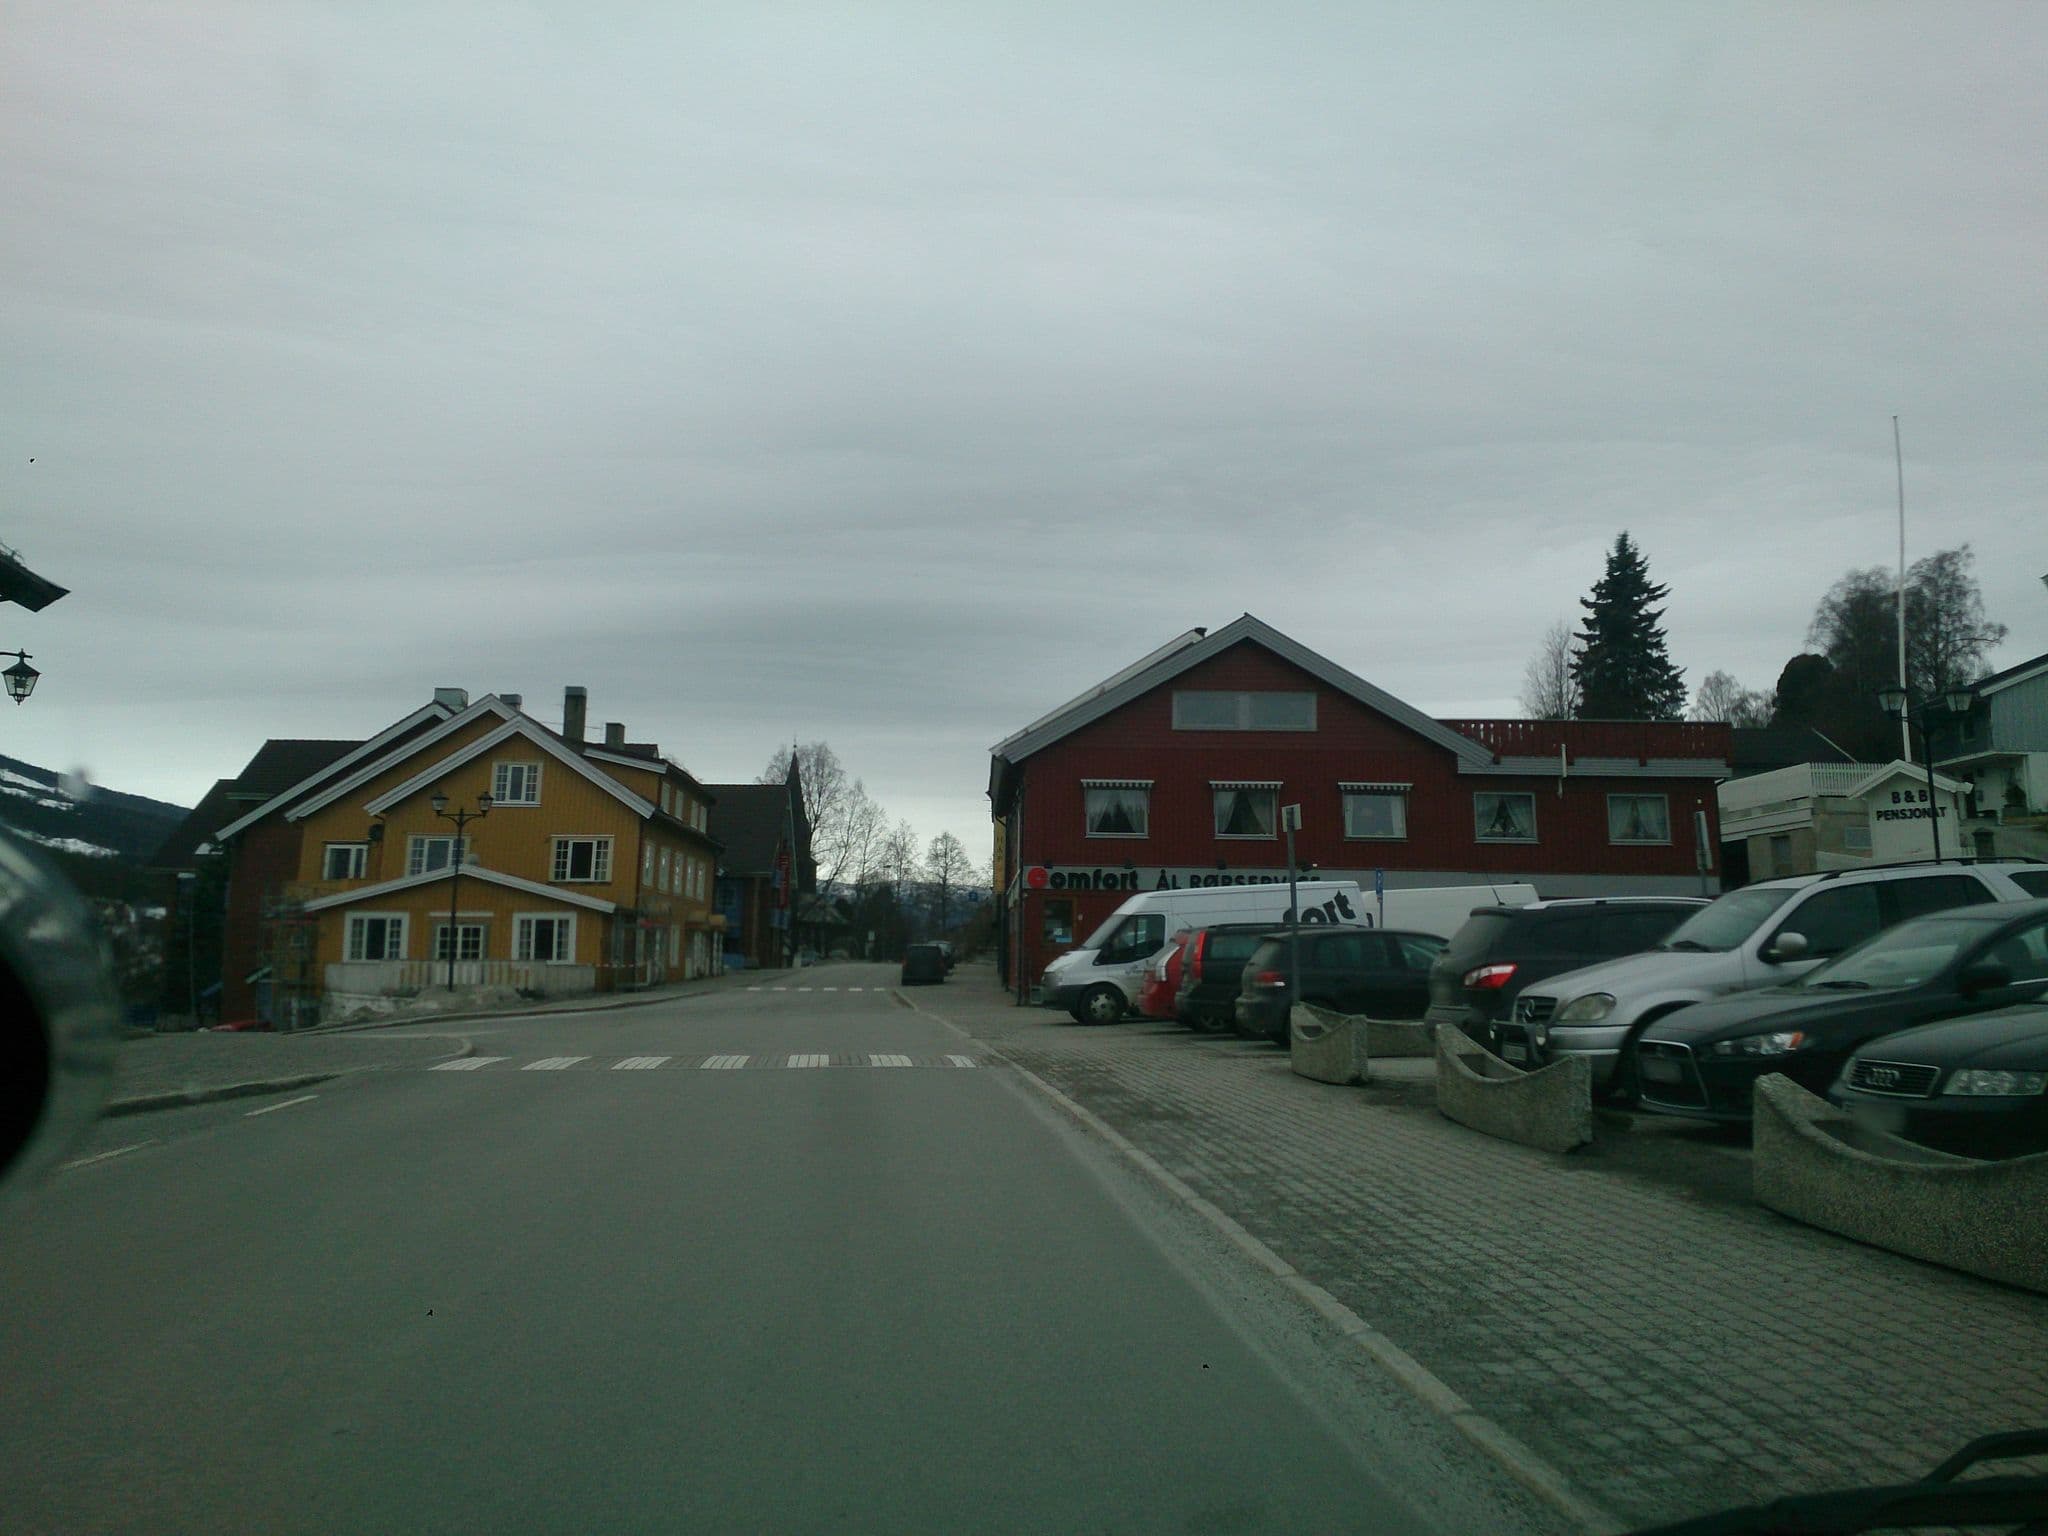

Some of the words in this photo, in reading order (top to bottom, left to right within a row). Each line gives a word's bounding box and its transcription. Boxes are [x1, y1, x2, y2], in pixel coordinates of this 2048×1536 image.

[1891, 791, 1901, 803] B
[1904, 790, 1916, 803] &
[1919, 790, 1928, 802] B
[1190, 874, 1321, 889] RØRSERV
